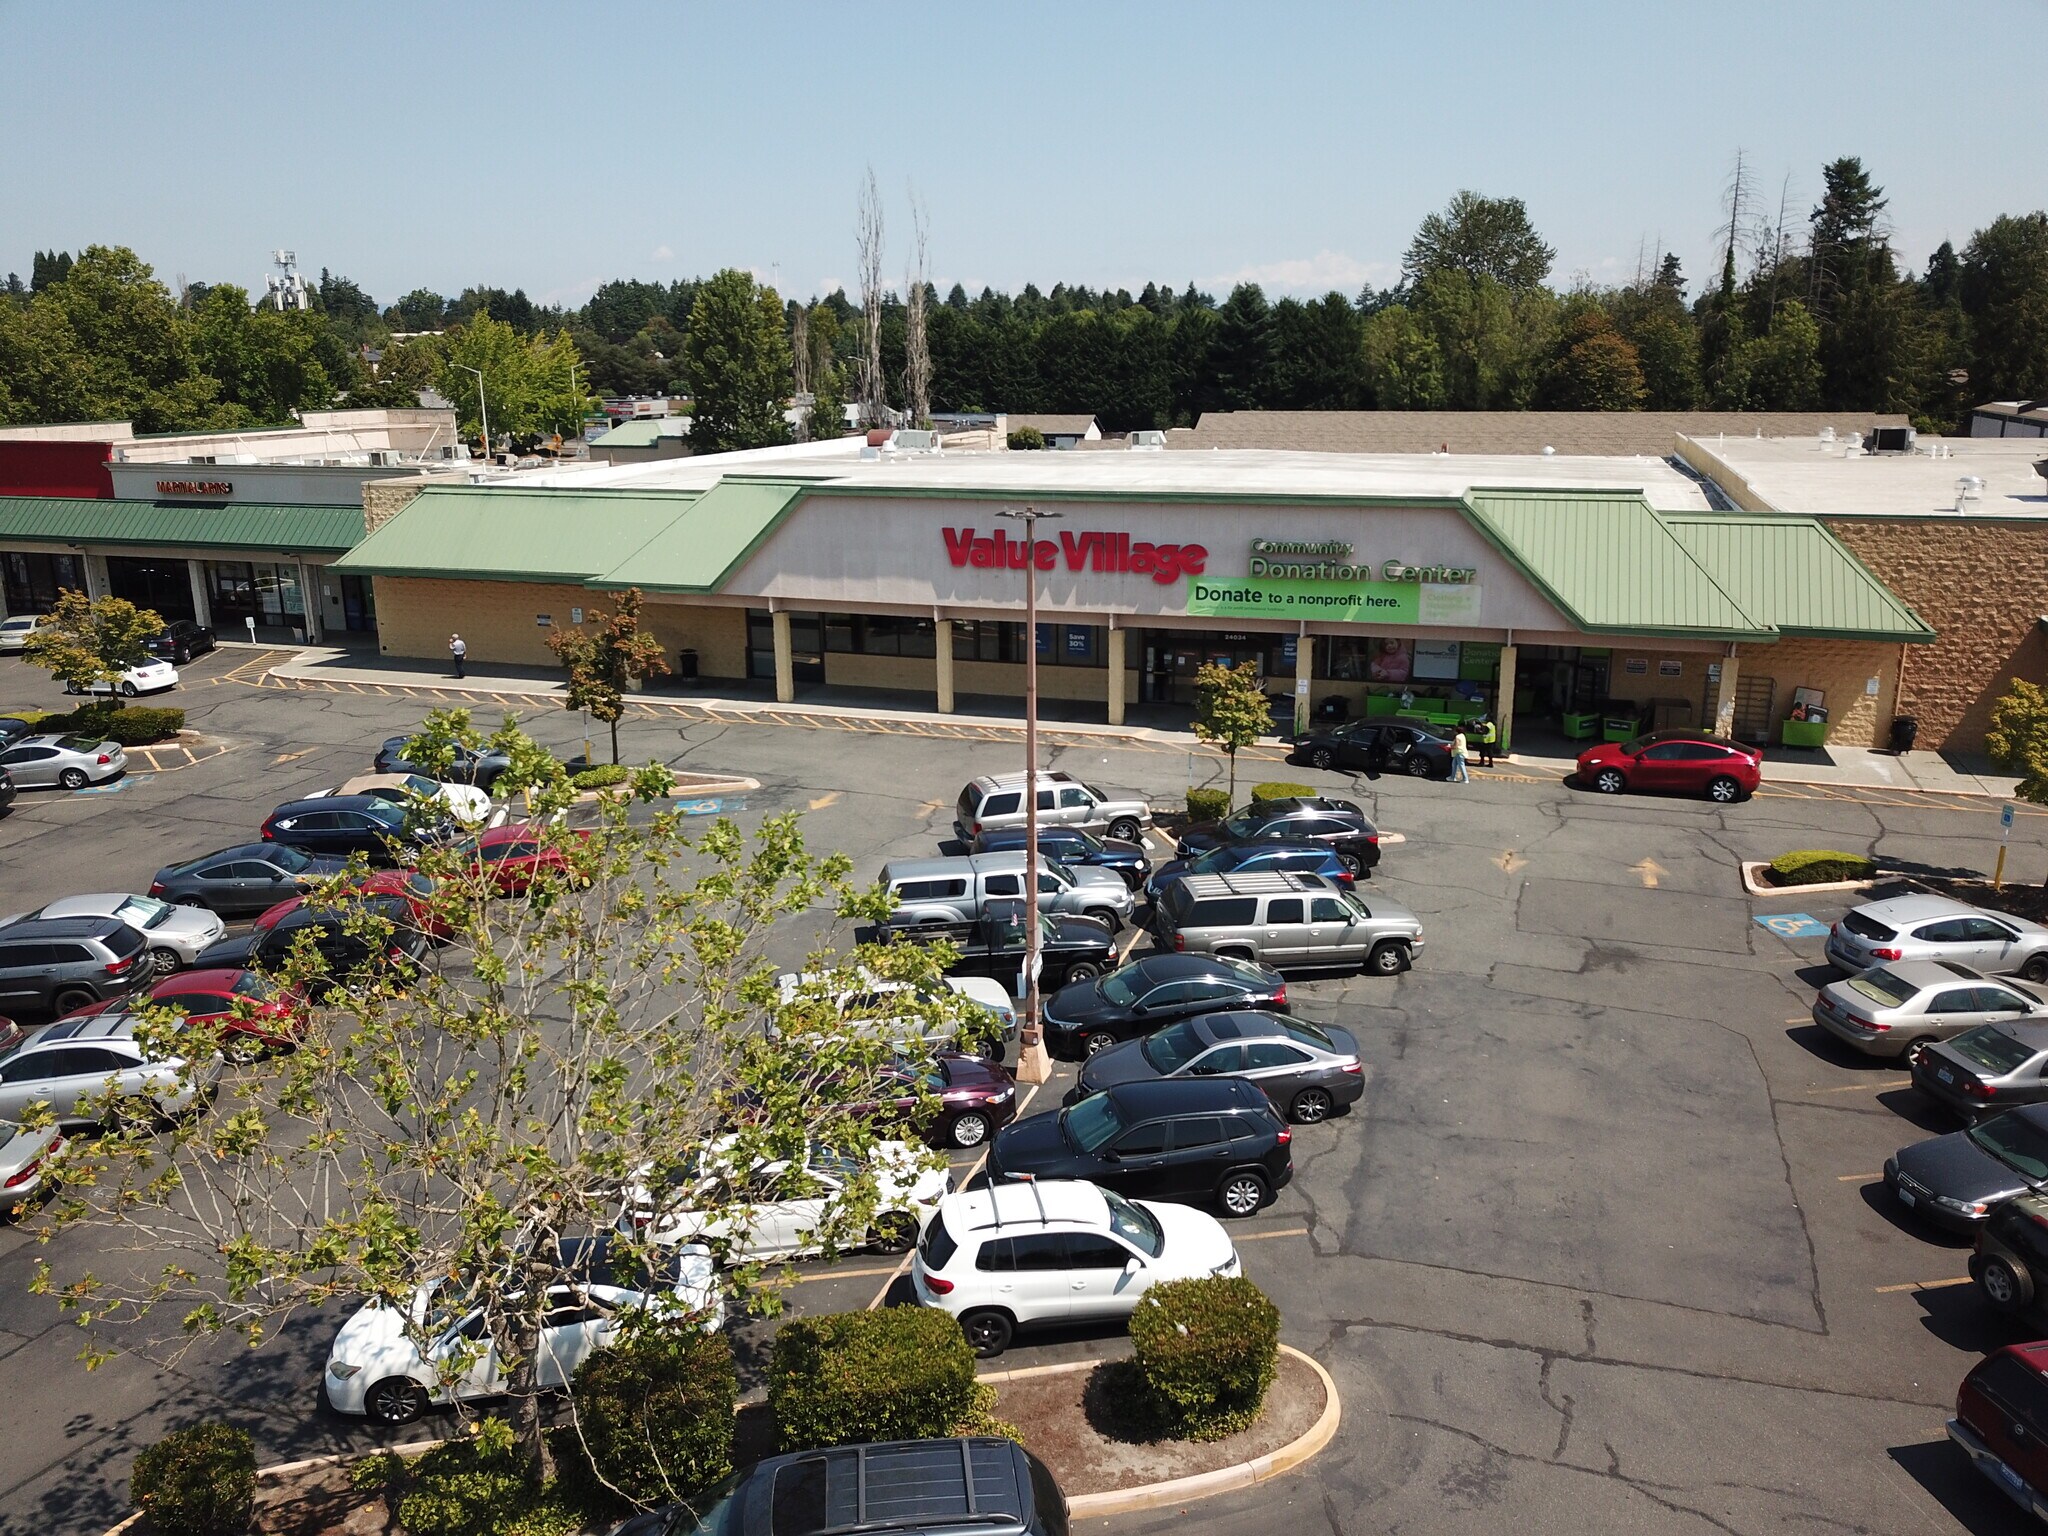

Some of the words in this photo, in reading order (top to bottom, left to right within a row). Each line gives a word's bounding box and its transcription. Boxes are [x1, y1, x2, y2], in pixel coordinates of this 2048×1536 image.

[156, 481, 203, 493] MARTIAL
[202, 482, 233, 494] ARTS
[942, 527, 1059, 571] Value
[1059, 531, 1209, 585] Village
[1251, 538, 1354, 557] Community
[1250, 556, 1371, 581] Donation
[1381, 559, 1477, 584] Center
[1195, 586, 1263, 602] Donate
[1268, 593, 1282, 603] to
[1286, 595, 1294, 604] a
[1299, 594, 1363, 607] nonprofit
[1366, 595, 1401, 608] here.
[1463, 648, 1500, 657] Donatio
